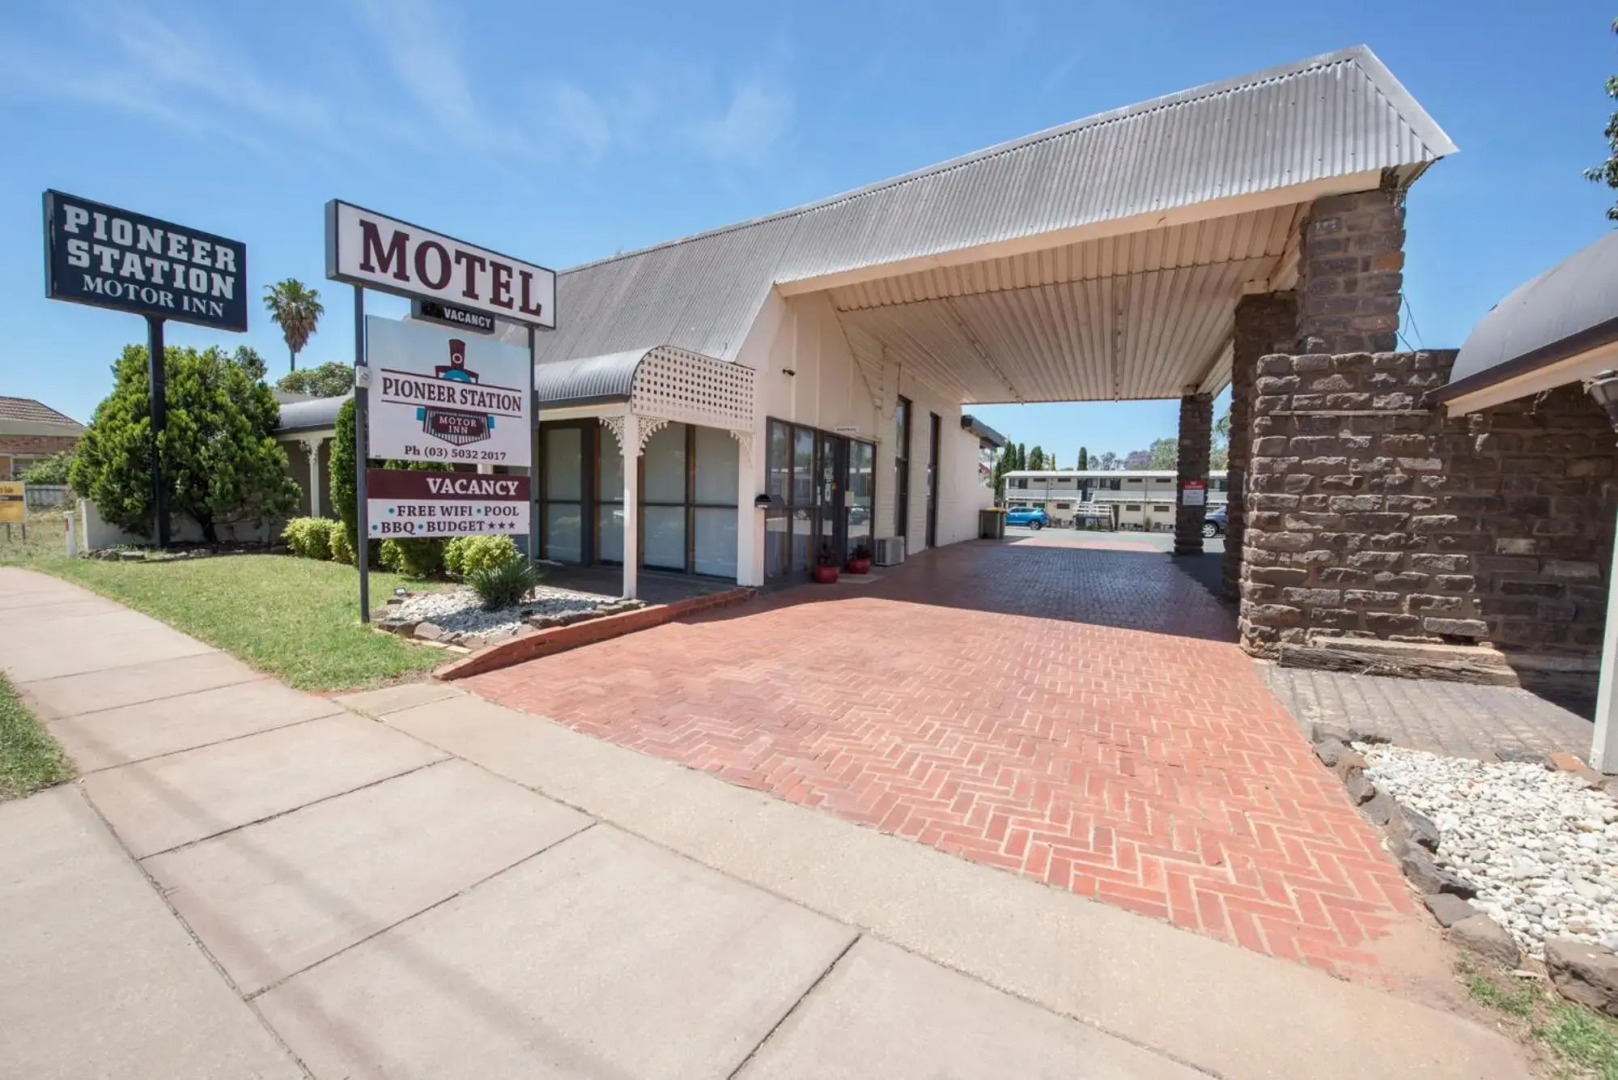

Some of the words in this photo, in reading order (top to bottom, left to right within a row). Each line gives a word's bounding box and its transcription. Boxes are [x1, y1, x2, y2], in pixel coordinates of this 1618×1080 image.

[63, 204, 236, 273] PIONEER
[67, 238, 235, 300] STATION
[359, 219, 542, 317] MOTEL
[83, 274, 175, 308] MOTOR
[182, 295, 224, 318] INN
[443, 307, 492, 329] VACANCY
[382, 377, 457, 404] PIONEER
[460, 388, 522, 412] STATION
[439, 416, 477, 427] MOTOR
[448, 425, 468, 435] INN
[404, 445, 420, 456] Ph
[424, 446, 448, 459] (03)
[451, 448, 478, 460] 5032
[481, 450, 507, 461] 2017
[426, 478, 519, 496] VACANCY
[397, 505, 436, 517] FREE
[440, 505, 473, 517] WIFI
[484, 505, 519, 517] POOL
[381, 521, 416, 535] BBQ
[426, 520, 485, 533] BUDGET
